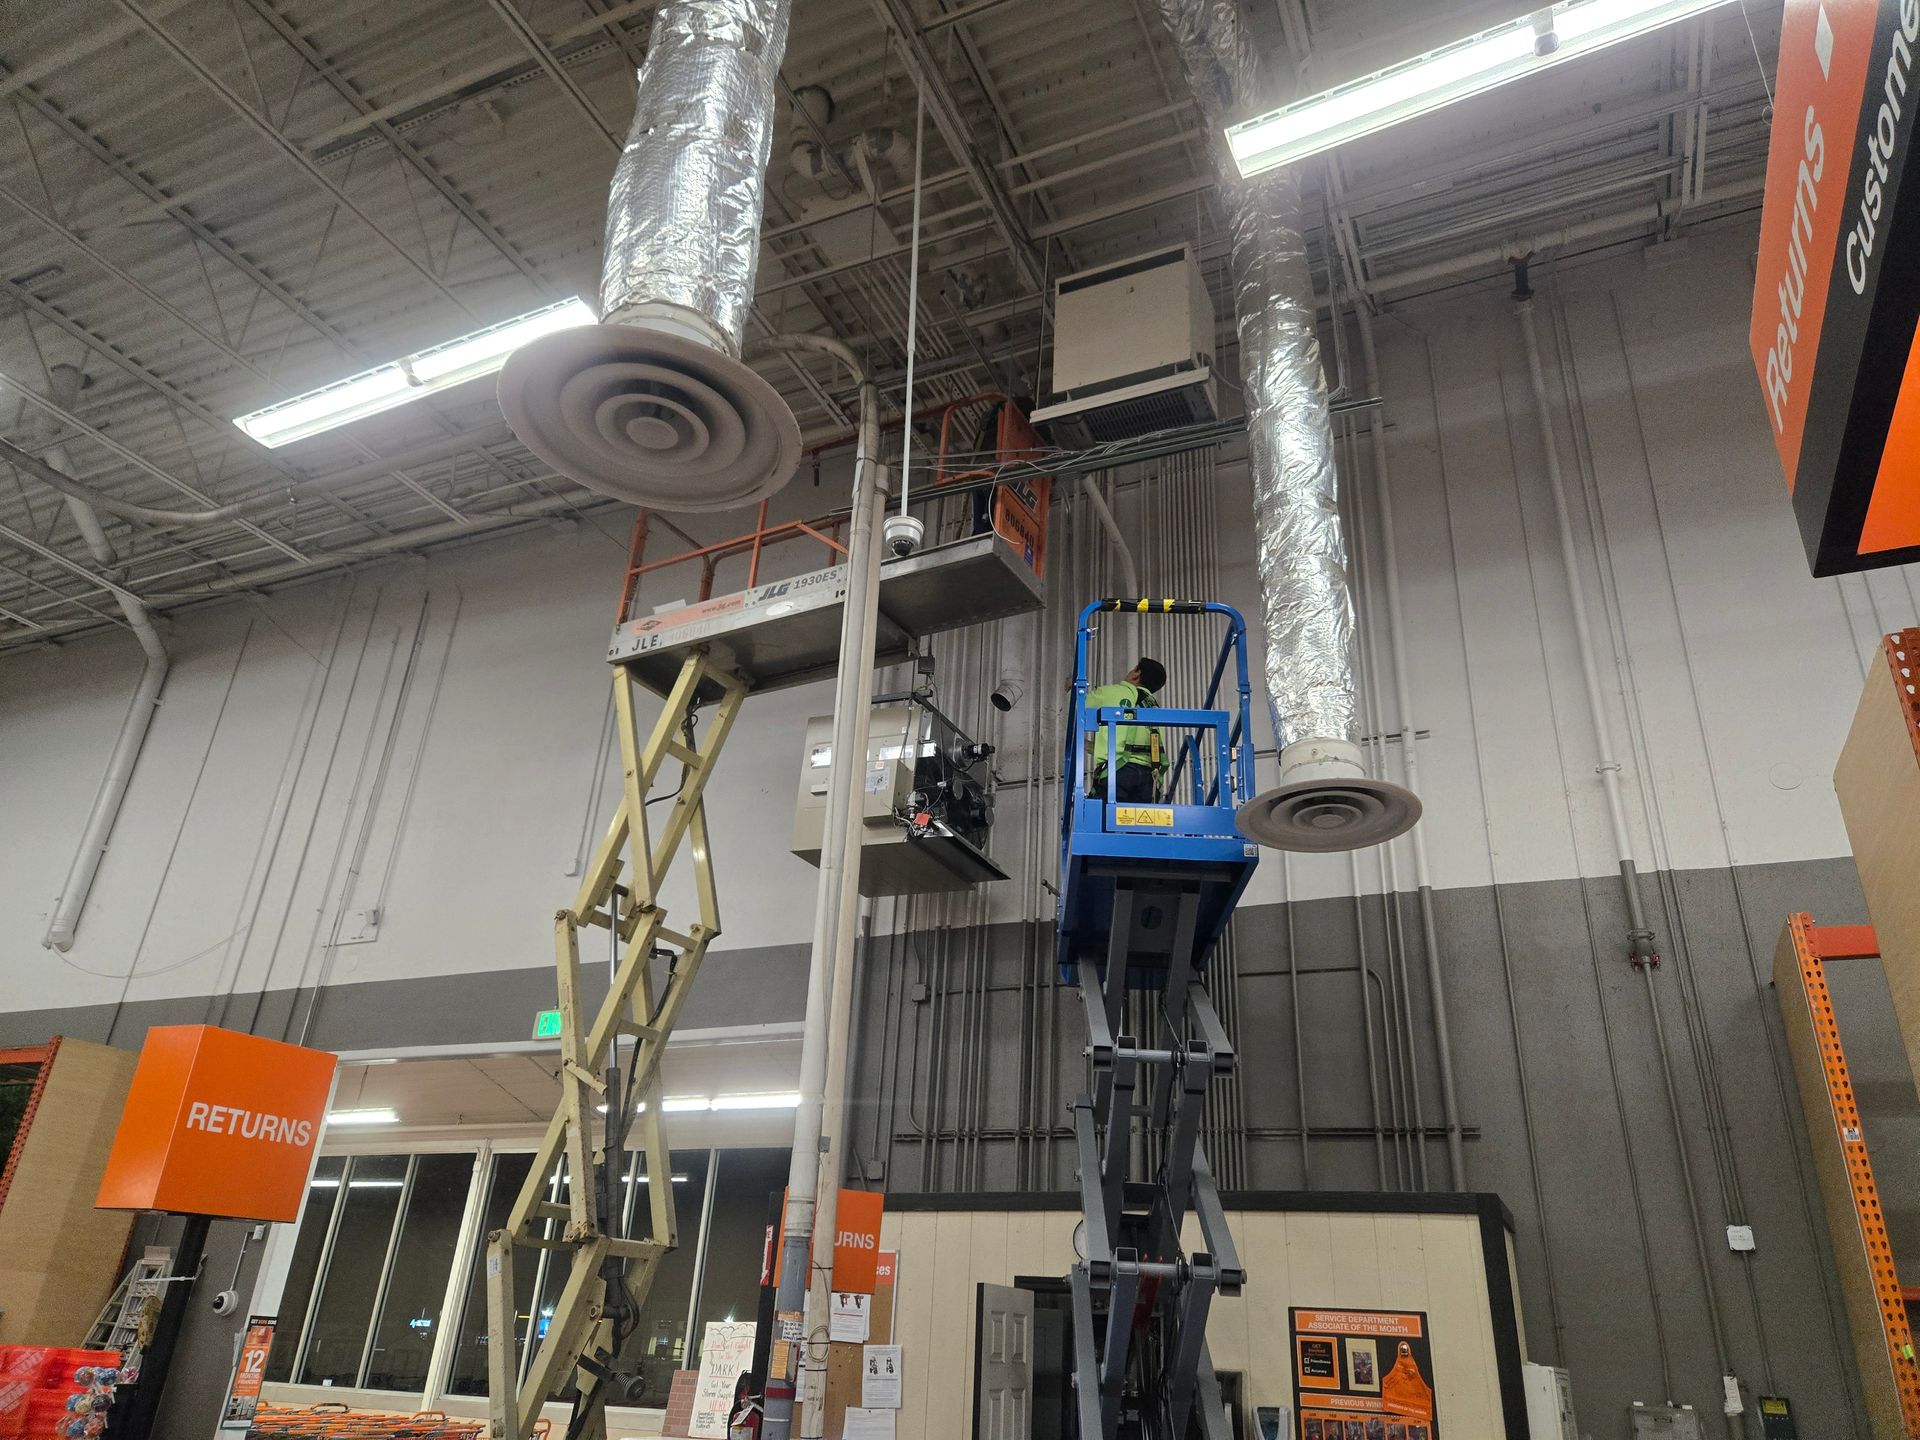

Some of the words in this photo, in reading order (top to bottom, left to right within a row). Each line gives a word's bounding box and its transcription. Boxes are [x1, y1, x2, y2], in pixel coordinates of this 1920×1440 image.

[1847, 0, 1920, 294] Custome
[1766, 105, 1824, 434] Returns
[758, 582, 791, 602] JLG
[793, 569, 838, 590] 1930ES
[186, 1101, 312, 1148] RETURNS
[834, 1231, 875, 1249] URNS
[1307, 1322, 1349, 1331] ASSOCIATE
[1362, 1324, 1378, 1332] THE
[1379, 1325, 1409, 1334] MONTH
[1314, 1313, 1347, 1323] SERVICE
[1348, 1315, 1399, 1326] DEPARTMENT
[244, 1349, 266, 1374] 12
[1330, 1398, 1365, 1408] PREVIOUS
[1365, 1400, 1382, 1409] WINN
